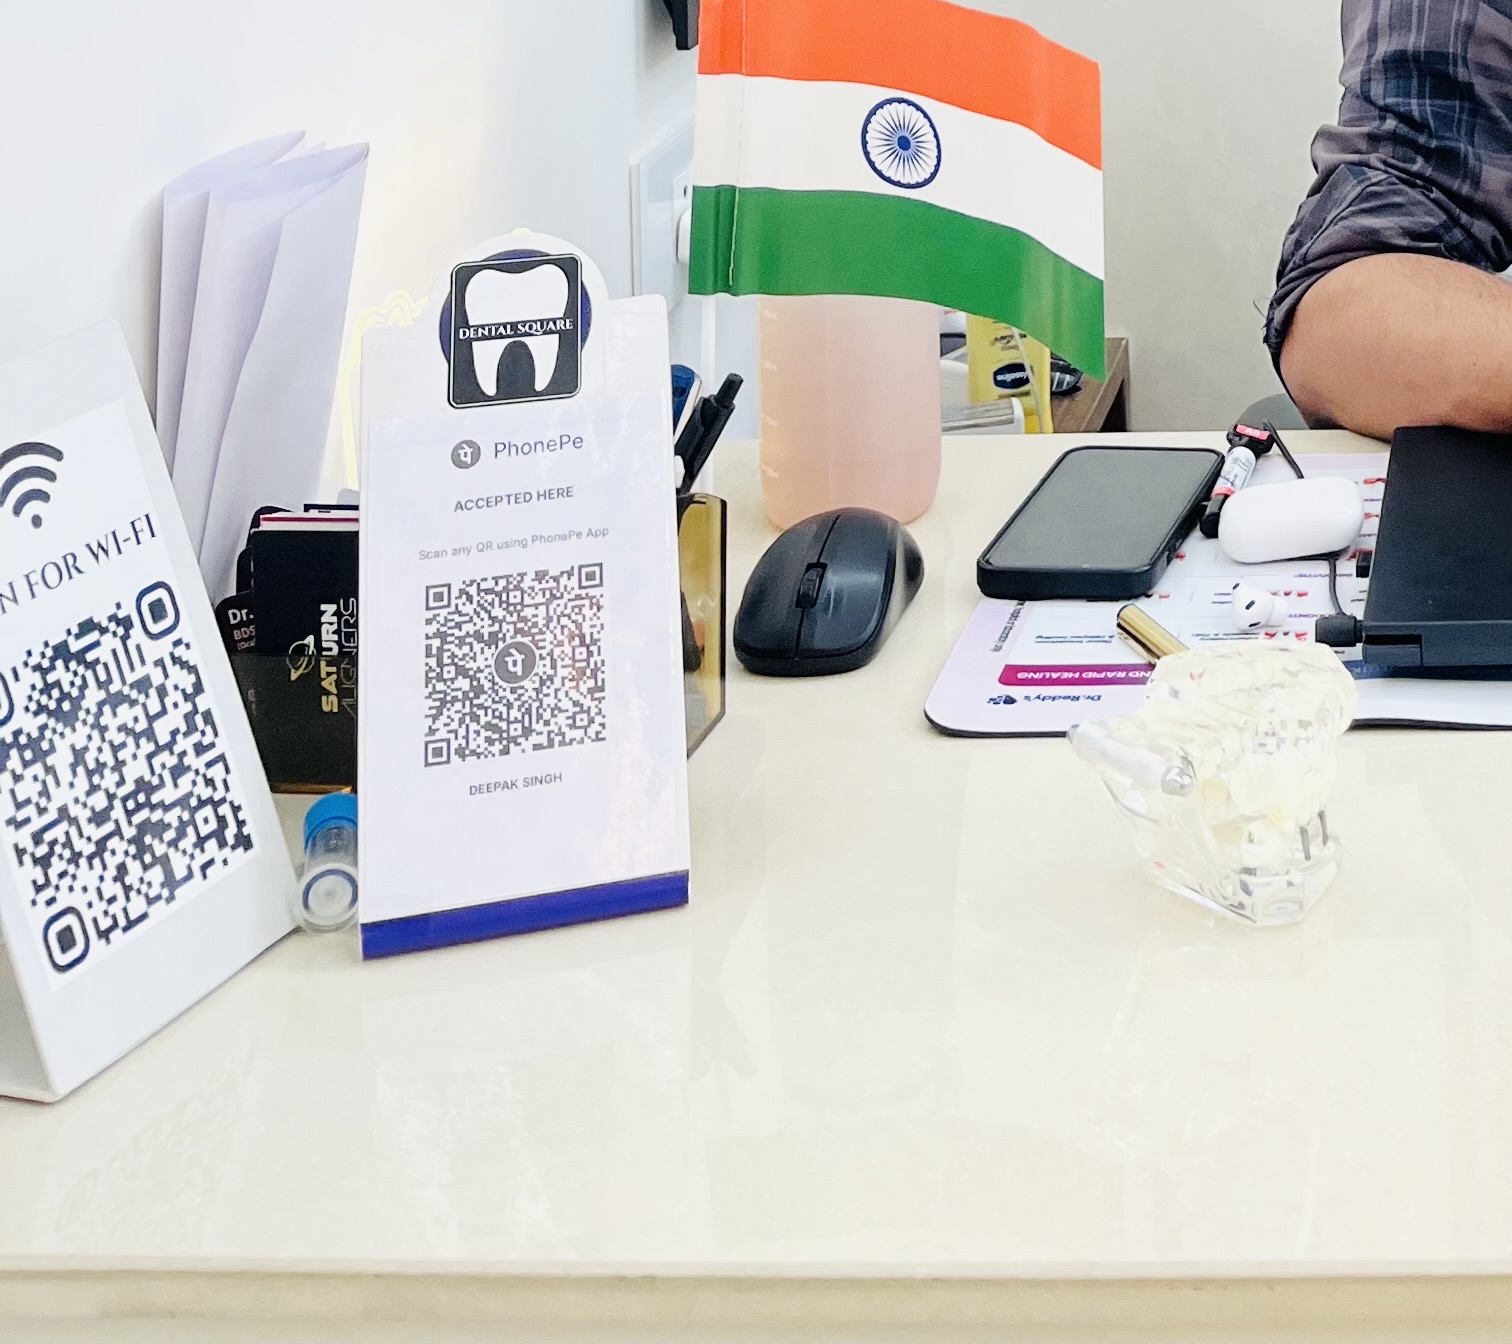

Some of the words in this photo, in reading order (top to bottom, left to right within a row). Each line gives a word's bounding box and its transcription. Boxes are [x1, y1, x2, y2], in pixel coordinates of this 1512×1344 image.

[458, 323, 514, 340] DENTAL
[517, 318, 574, 337] SQUARE
[494, 433, 584, 459] PhonePe
[454, 491, 533, 513] ACCEPTED
[536, 485, 575, 506] HERE
[23, 552, 85, 600] FOR
[83, 512, 156, 565] WI-FI
[418, 547, 448, 561] Scan
[451, 544, 473, 558] any
[476, 539, 494, 554] QR
[496, 535, 529, 552] using
[531, 529, 583, 546] PhonePe
[586, 526, 610, 541] App
[227, 607, 255, 625] Dr.
[321, 602, 339, 714] SATURN
[1016, 670, 1080, 681] HEALING
[1082, 669, 1126, 680] RAPID
[468, 777, 519, 797] DEEPAK
[522, 771, 563, 790] SINGH
